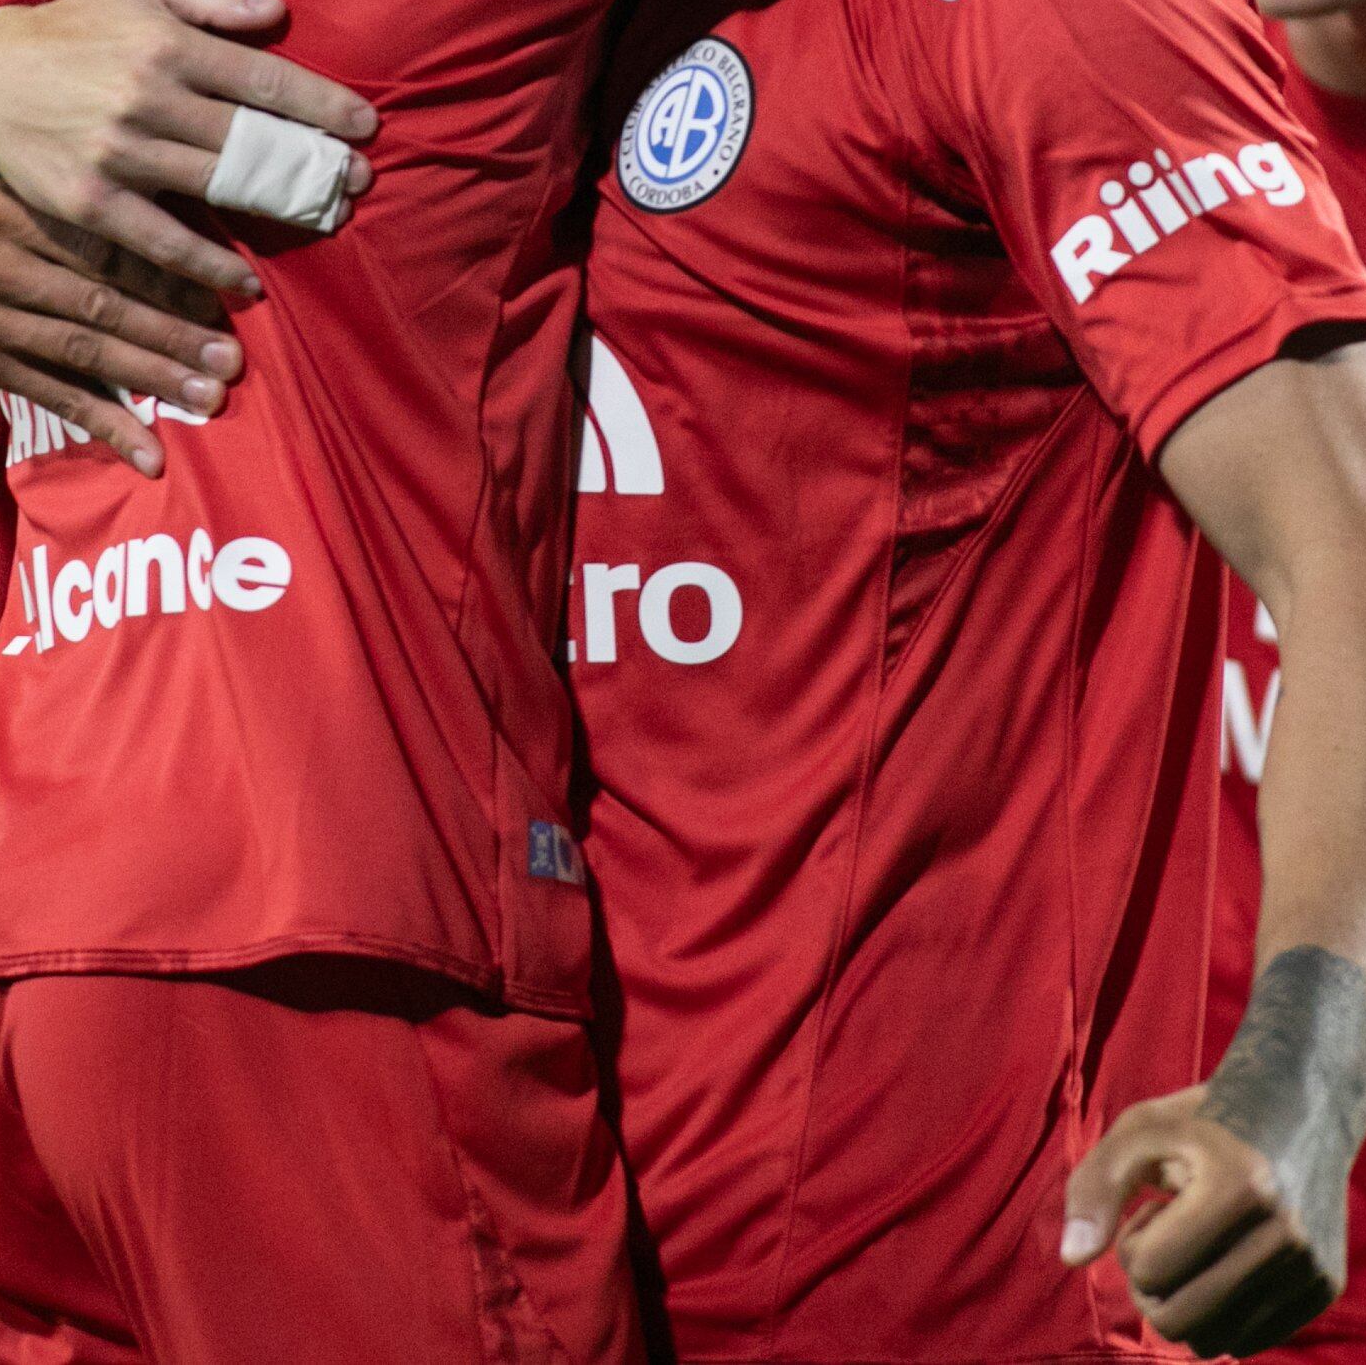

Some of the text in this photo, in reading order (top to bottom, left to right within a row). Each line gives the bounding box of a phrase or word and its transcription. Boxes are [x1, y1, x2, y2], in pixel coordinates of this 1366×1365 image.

[717, 54, 746, 162] BELGRANO
[628, 175, 705, 205] CORDOBA
[1050, 141, 1306, 306] Riiing
[567, 561, 744, 665] ro
